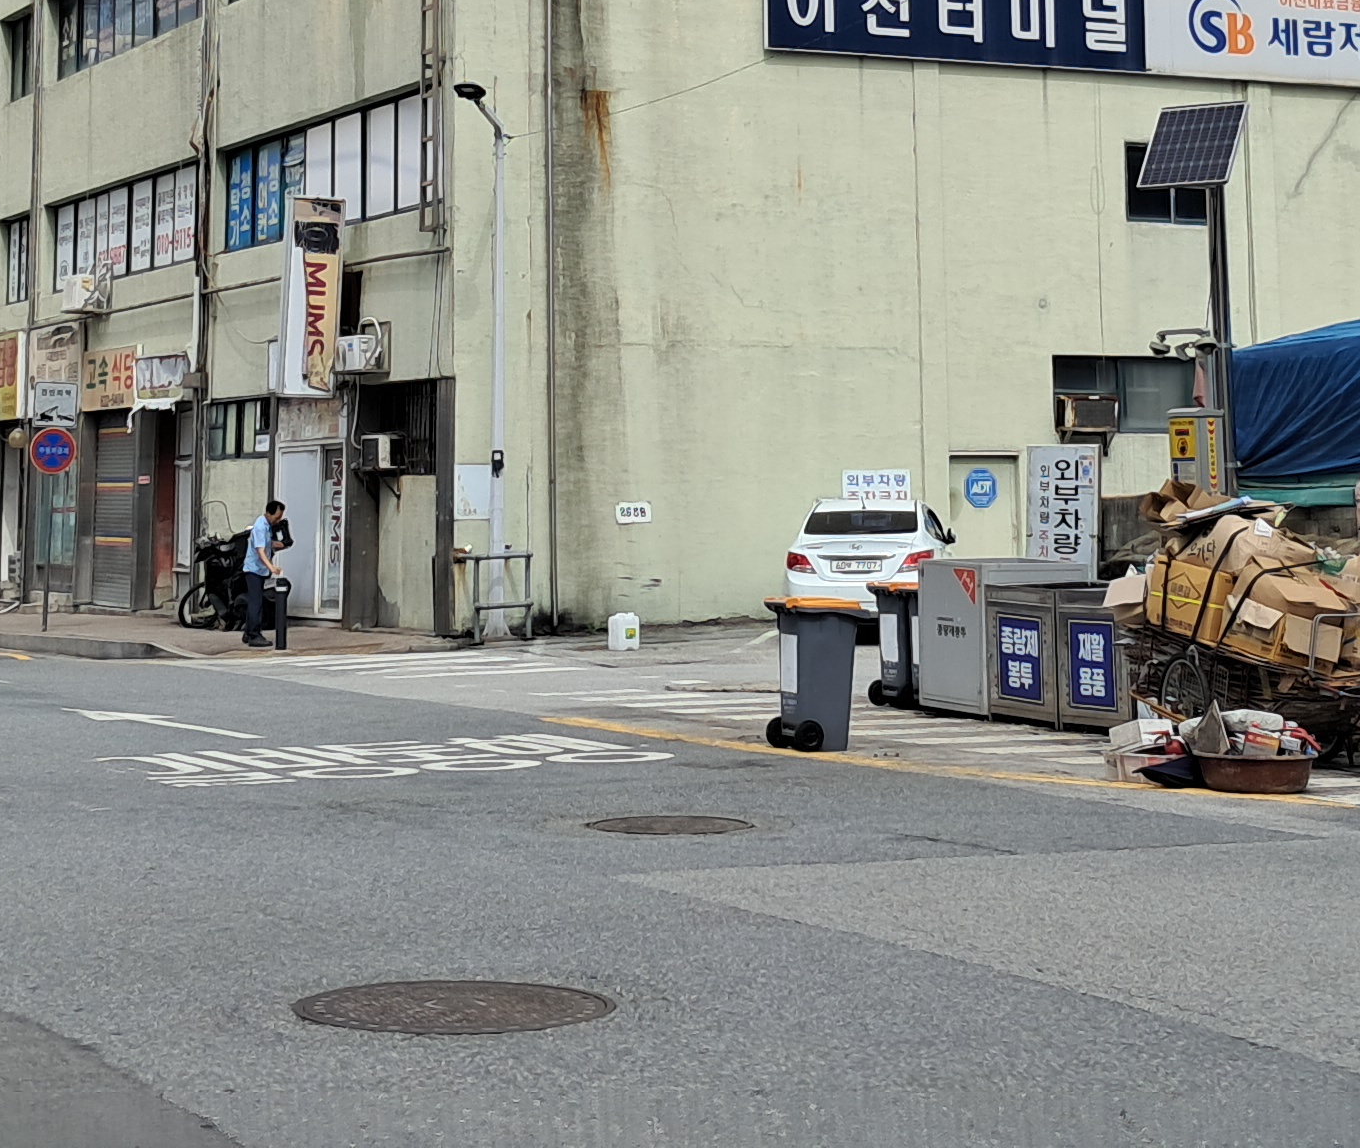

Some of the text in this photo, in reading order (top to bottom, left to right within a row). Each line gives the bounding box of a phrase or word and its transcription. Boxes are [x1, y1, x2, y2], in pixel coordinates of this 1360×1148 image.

[305, 262, 328, 357] MUMS
[86, 355, 109, 392] 고속
[112, 352, 135, 391] 식당
[846, 473, 907, 487] 외부차량
[971, 480, 993, 494] ADT
[330, 458, 344, 566] MUMS
[1053, 459, 1081, 555] 외부차량
[856, 562, 877, 570] 7707
[1001, 626, 1039, 658] 종량제
[1078, 633, 1105, 662] 재활
[1008, 660, 1034, 690] 봉투
[1079, 667, 1106, 697] 용품
